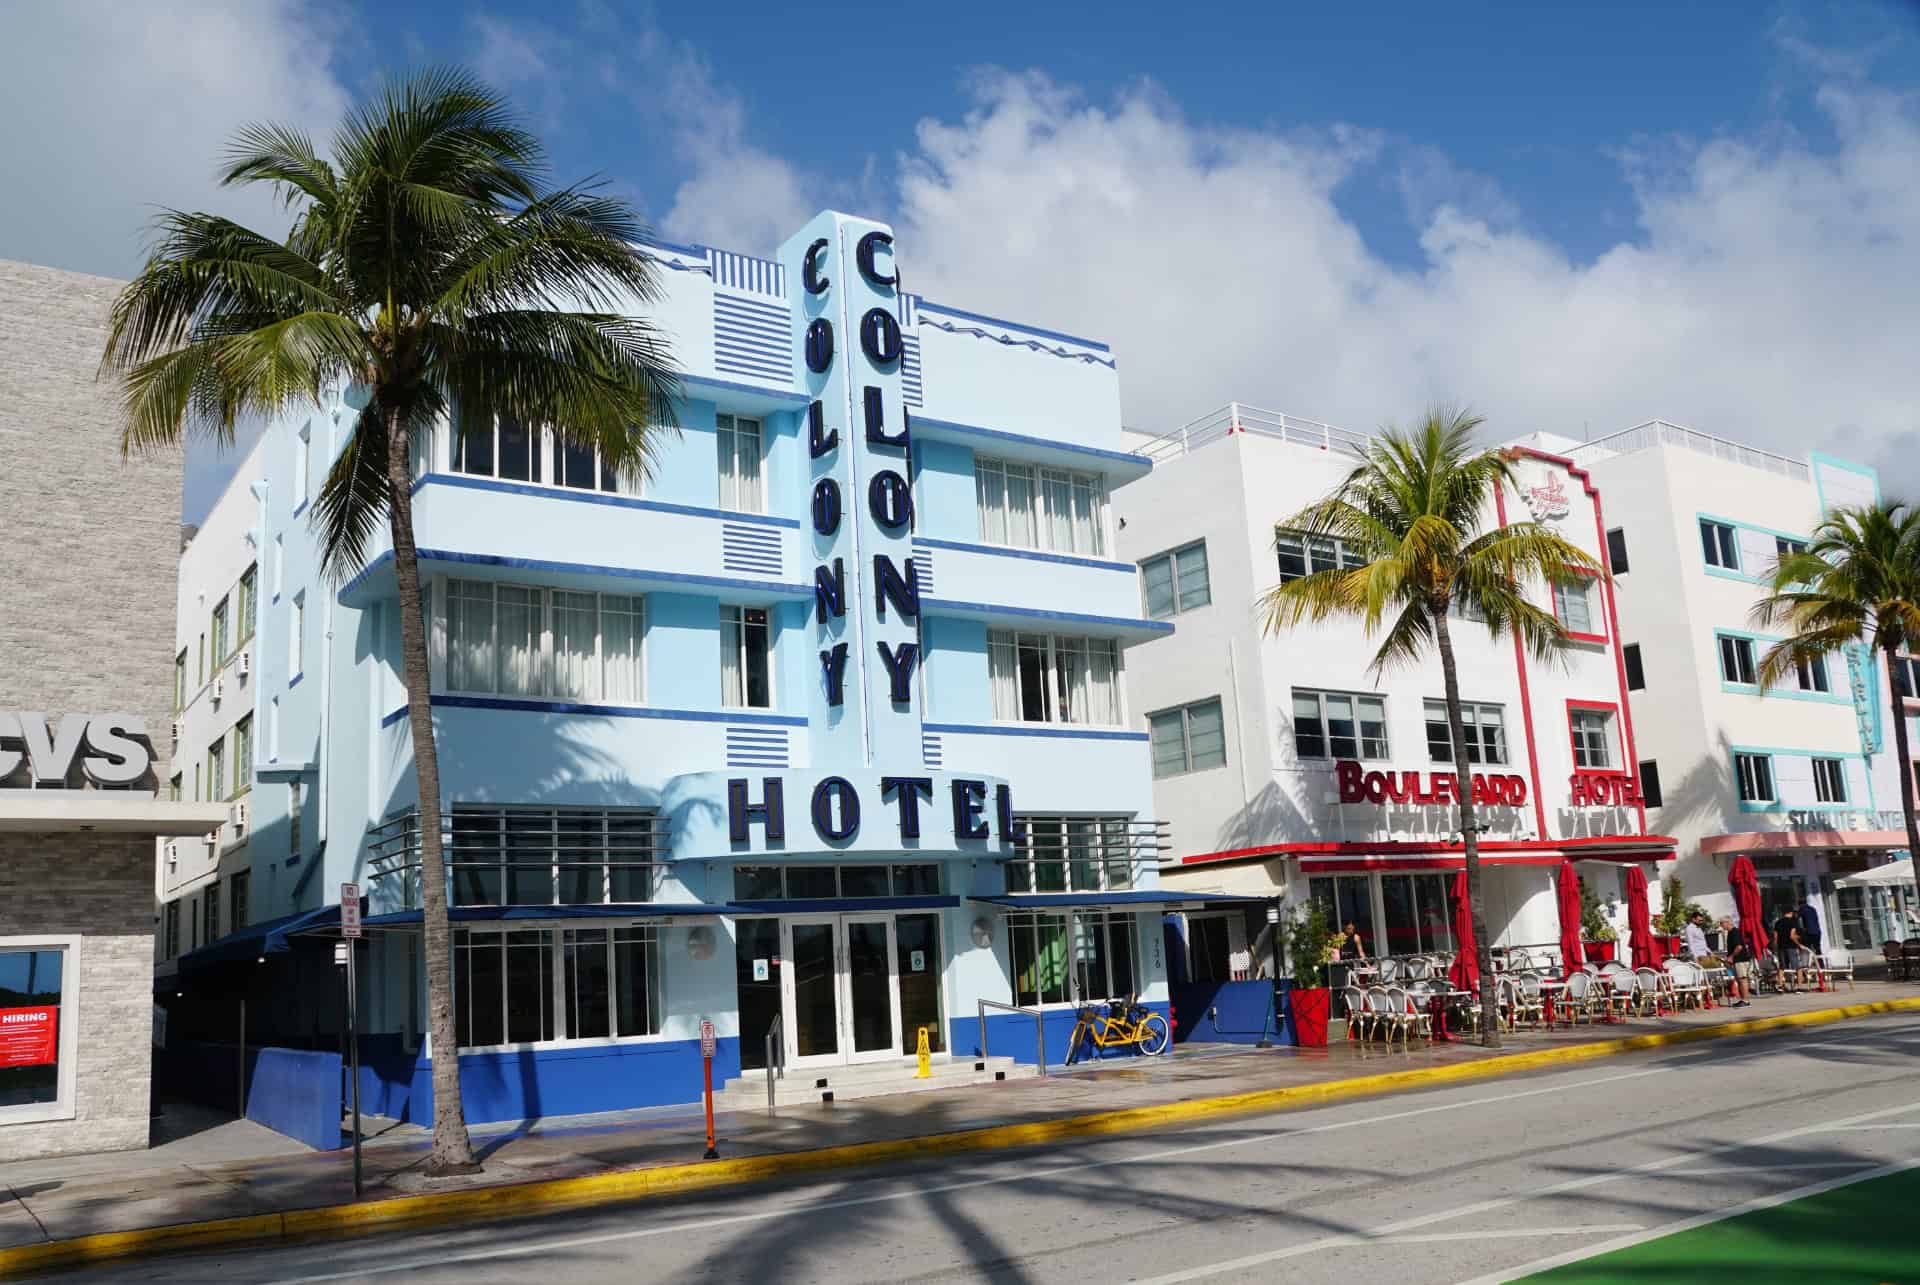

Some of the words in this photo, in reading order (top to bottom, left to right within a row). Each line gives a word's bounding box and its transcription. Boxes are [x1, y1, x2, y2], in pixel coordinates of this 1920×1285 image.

[804, 238, 849, 707] COLONY
[856, 231, 921, 703] COLONY
[728, 775, 1026, 843] HOTEL
[1569, 774, 1646, 807] HOTEL
[2, 1012, 48, 1024] HIRING
